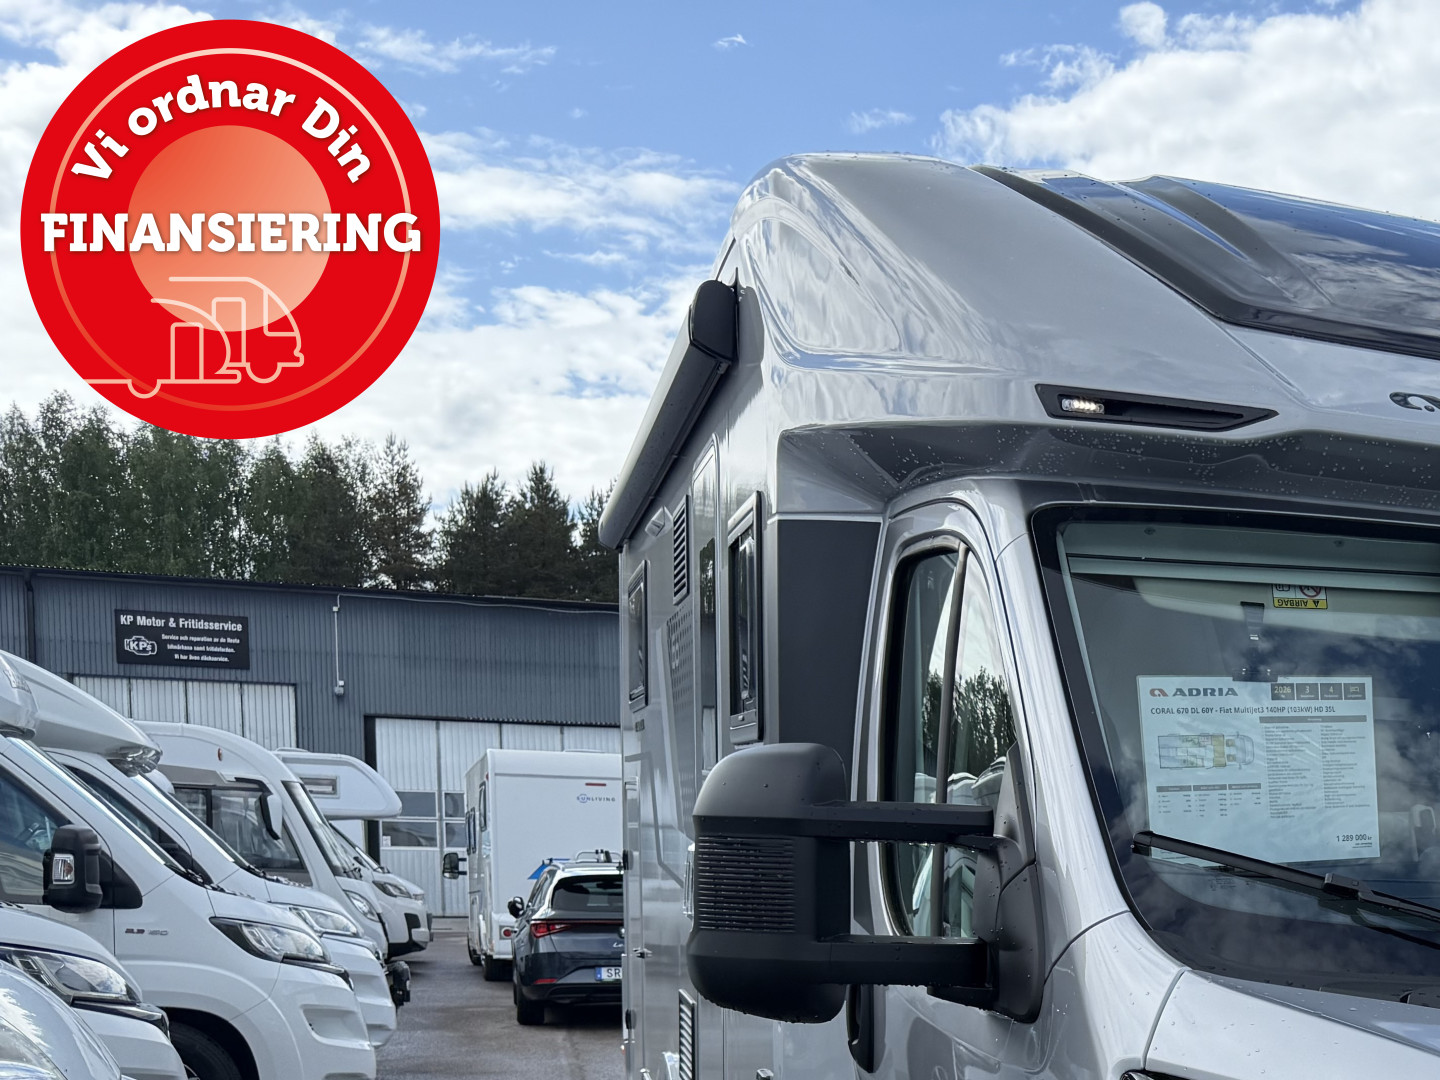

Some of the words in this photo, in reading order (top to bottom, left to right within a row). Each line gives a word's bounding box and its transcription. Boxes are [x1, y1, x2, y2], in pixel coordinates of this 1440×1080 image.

[1277, 598, 1308, 607] AIRBAG
[120, 614, 134, 625] KP
[136, 615, 166, 628] Motor
[168, 617, 177, 628] &
[179, 617, 242, 632] Fritidsservice
[1172, 687, 1239, 697] ADRIA
[1274, 686, 1292, 694] 2026
[1150, 707, 1175, 715] CORAL
[1219, 706, 1233, 714] Fiat
[576, 793, 616, 804] SUNLIVING
[1341, 834, 1354, 842] 289
[1354, 833, 1367, 841] 000
[606, 968, 621, 978] SR
